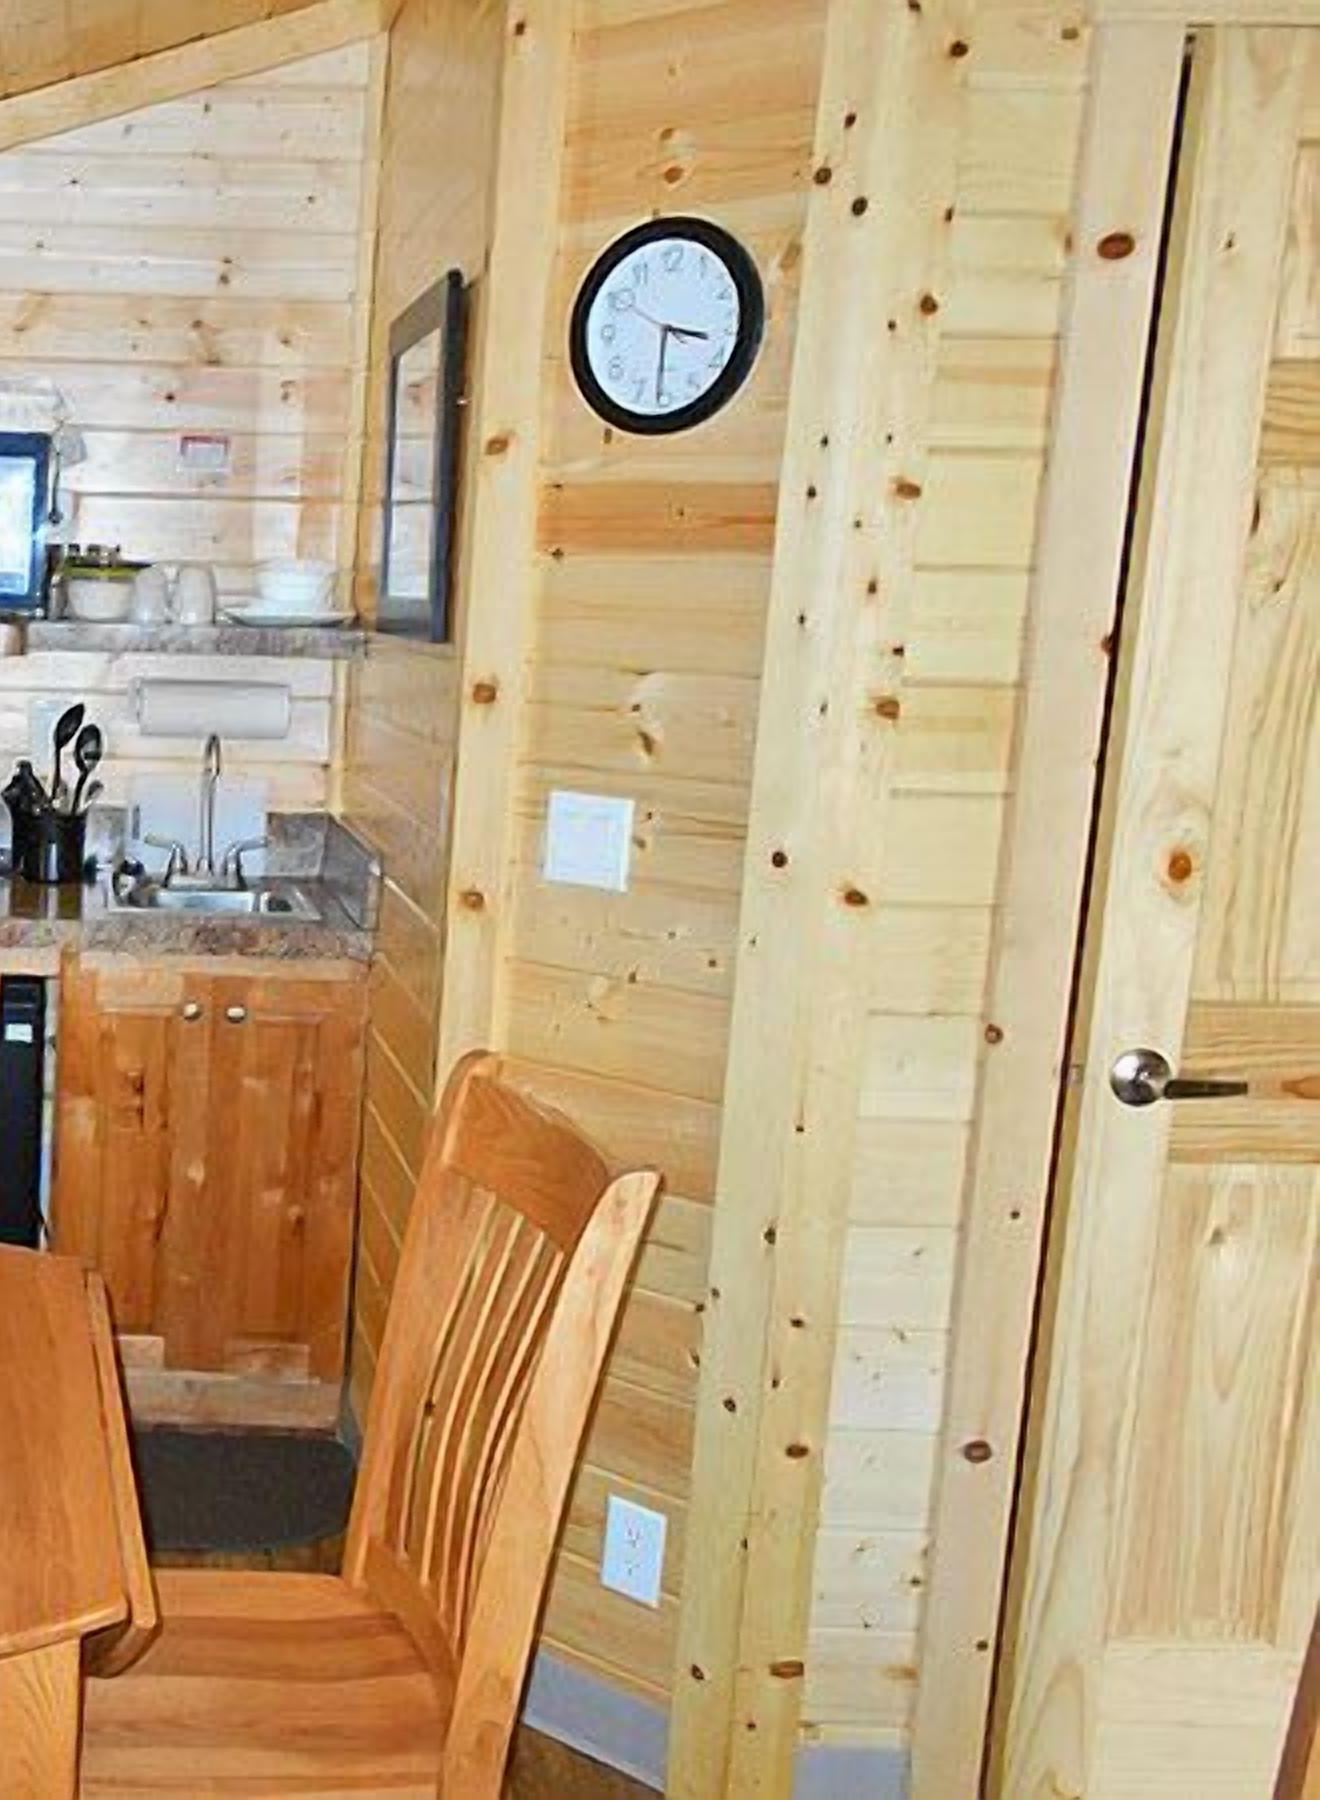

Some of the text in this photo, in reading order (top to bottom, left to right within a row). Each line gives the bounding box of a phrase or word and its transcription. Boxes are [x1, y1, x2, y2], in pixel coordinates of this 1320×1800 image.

[660, 244, 685, 272] 12
[632, 261, 649, 287] 11
[608, 288, 636, 312] 10
[600, 323, 616, 345] 9
[608, 355, 624, 382] 8
[708, 345, 726, 368] 4
[631, 377, 647, 402] 7
